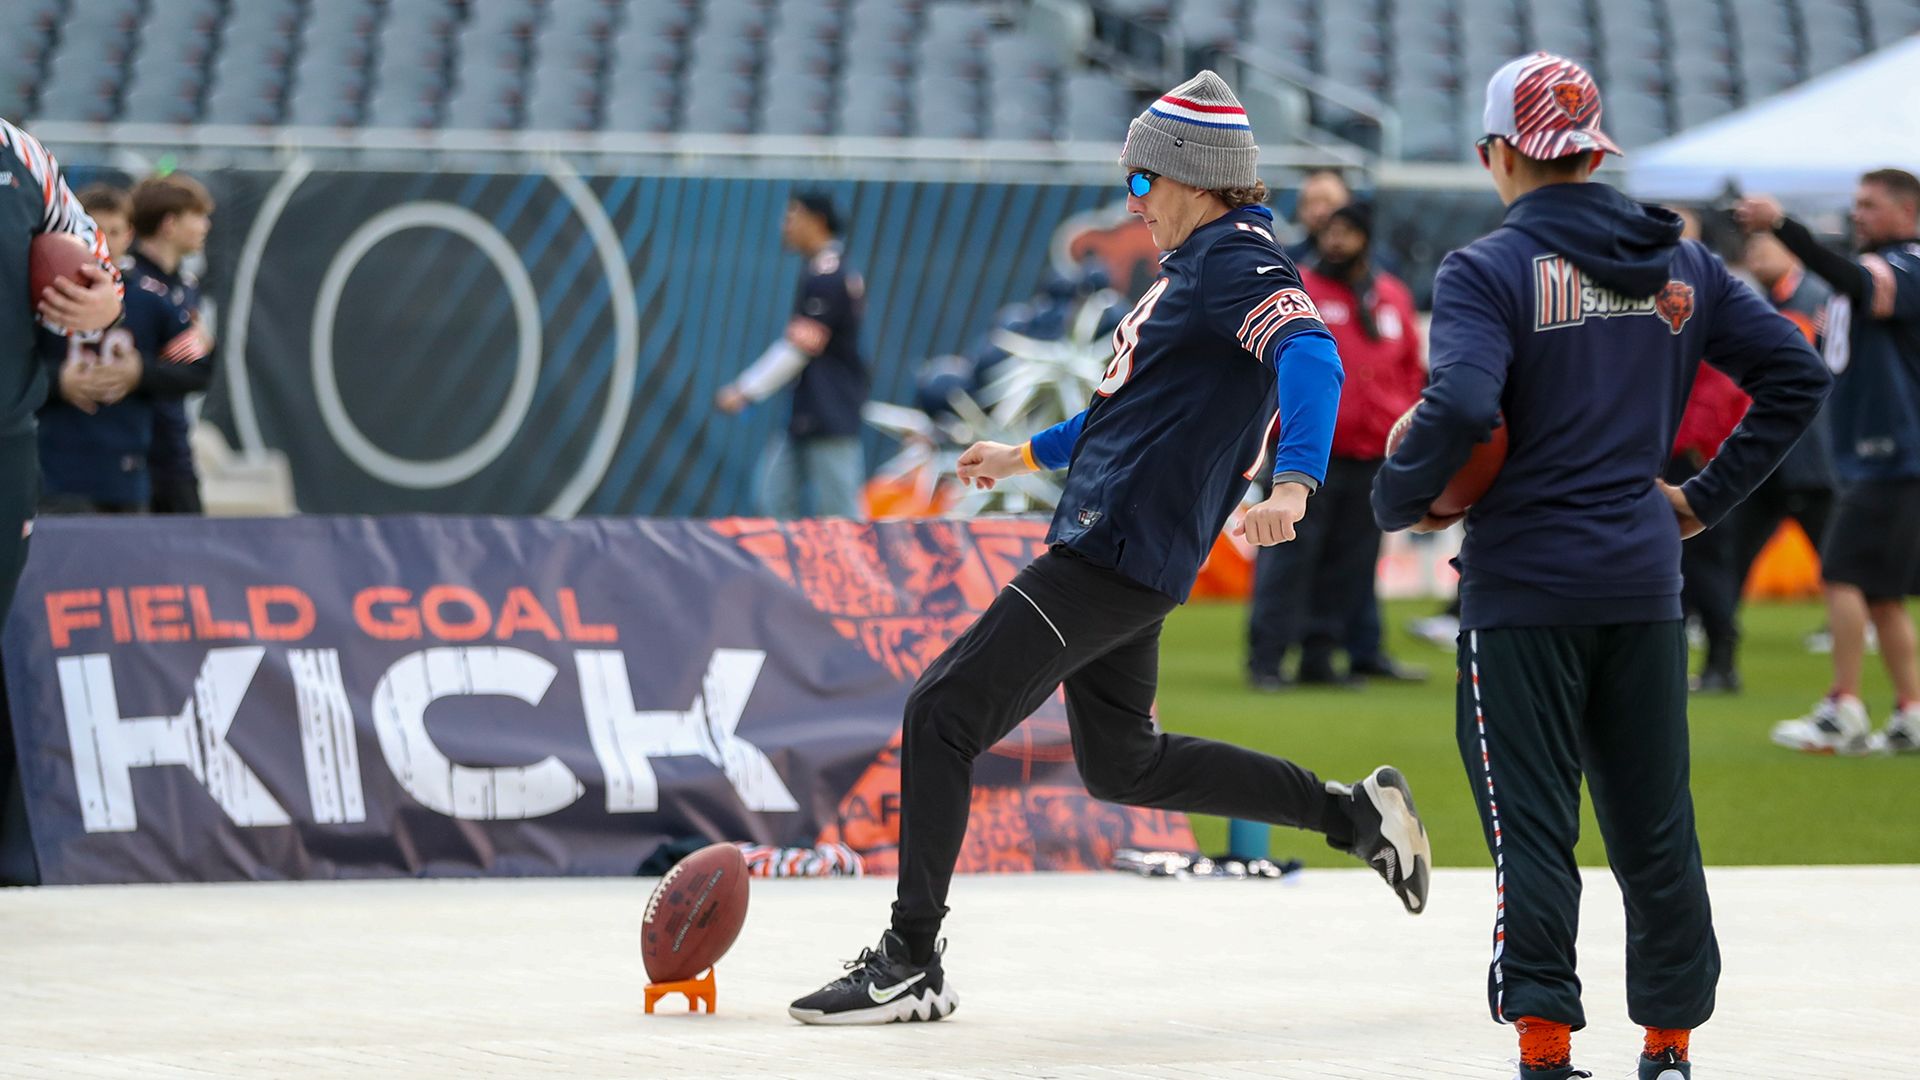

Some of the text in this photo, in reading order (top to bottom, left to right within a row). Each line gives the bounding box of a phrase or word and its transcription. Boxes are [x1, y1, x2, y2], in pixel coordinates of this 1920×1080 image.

[45, 584, 619, 648] FIELD GOAL
[56, 645, 800, 834] KICK
